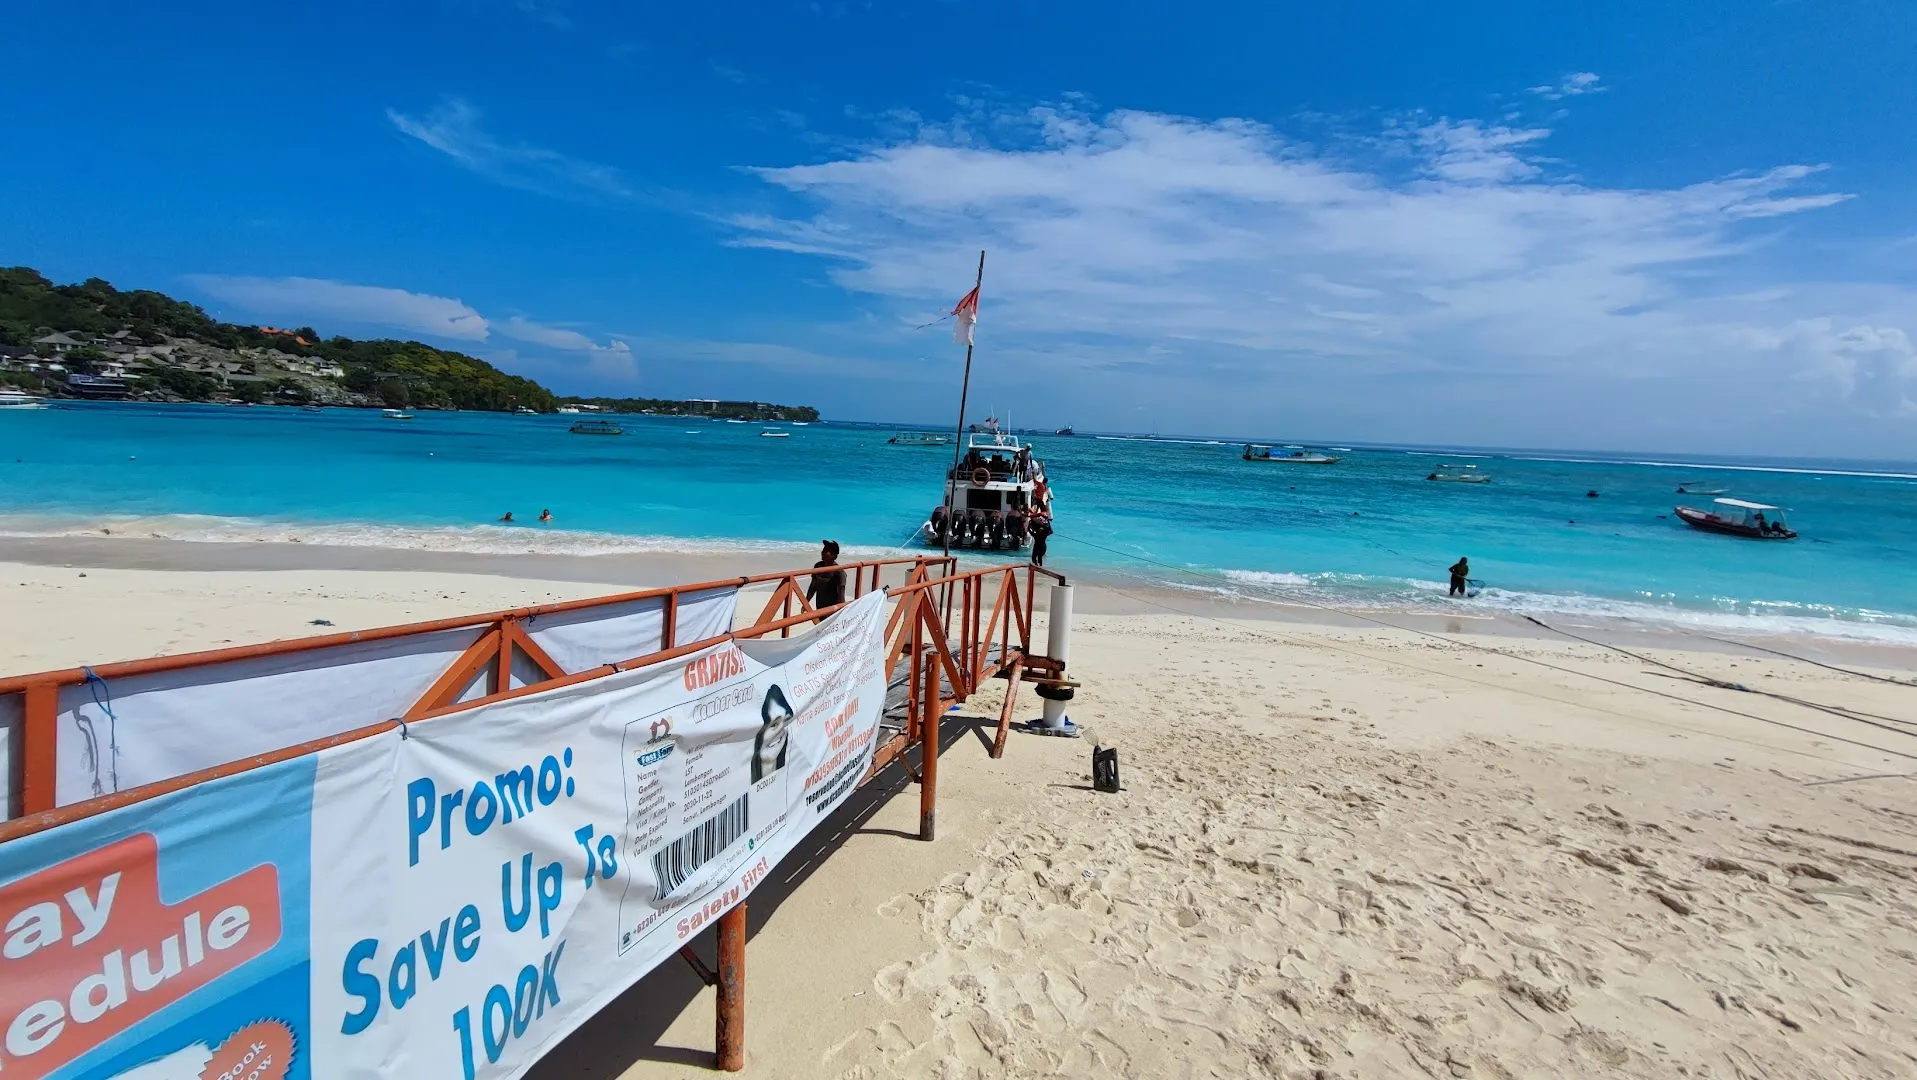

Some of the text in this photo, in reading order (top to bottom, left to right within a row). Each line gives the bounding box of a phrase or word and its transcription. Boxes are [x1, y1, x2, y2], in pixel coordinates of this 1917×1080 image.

[684, 646, 747, 692] GRATIS!!
[794, 677, 820, 697] GRATIS
[692, 683, 754, 724] Member Card
[637, 769, 657, 782] Name
[638, 752, 703, 794] Gender Female
[407, 747, 575, 868] Promo:
[637, 795, 665, 818] Nationality
[638, 786, 663, 806] Company
[635, 832, 648, 844] Date
[648, 816, 668, 838] Expired
[636, 817, 648, 830] Visa
[633, 842, 648, 857] Valid
[649, 835, 663, 851] Trips
[677, 885, 741, 940] Safety
[741, 856, 769, 892] First
[340, 823, 618, 1035] Save Up To
[0, 905, 250, 1068] edule
[453, 939, 566, 1080] 100K
[216, 1040, 267, 1080] Book
[240, 1054, 272, 1080] ow
